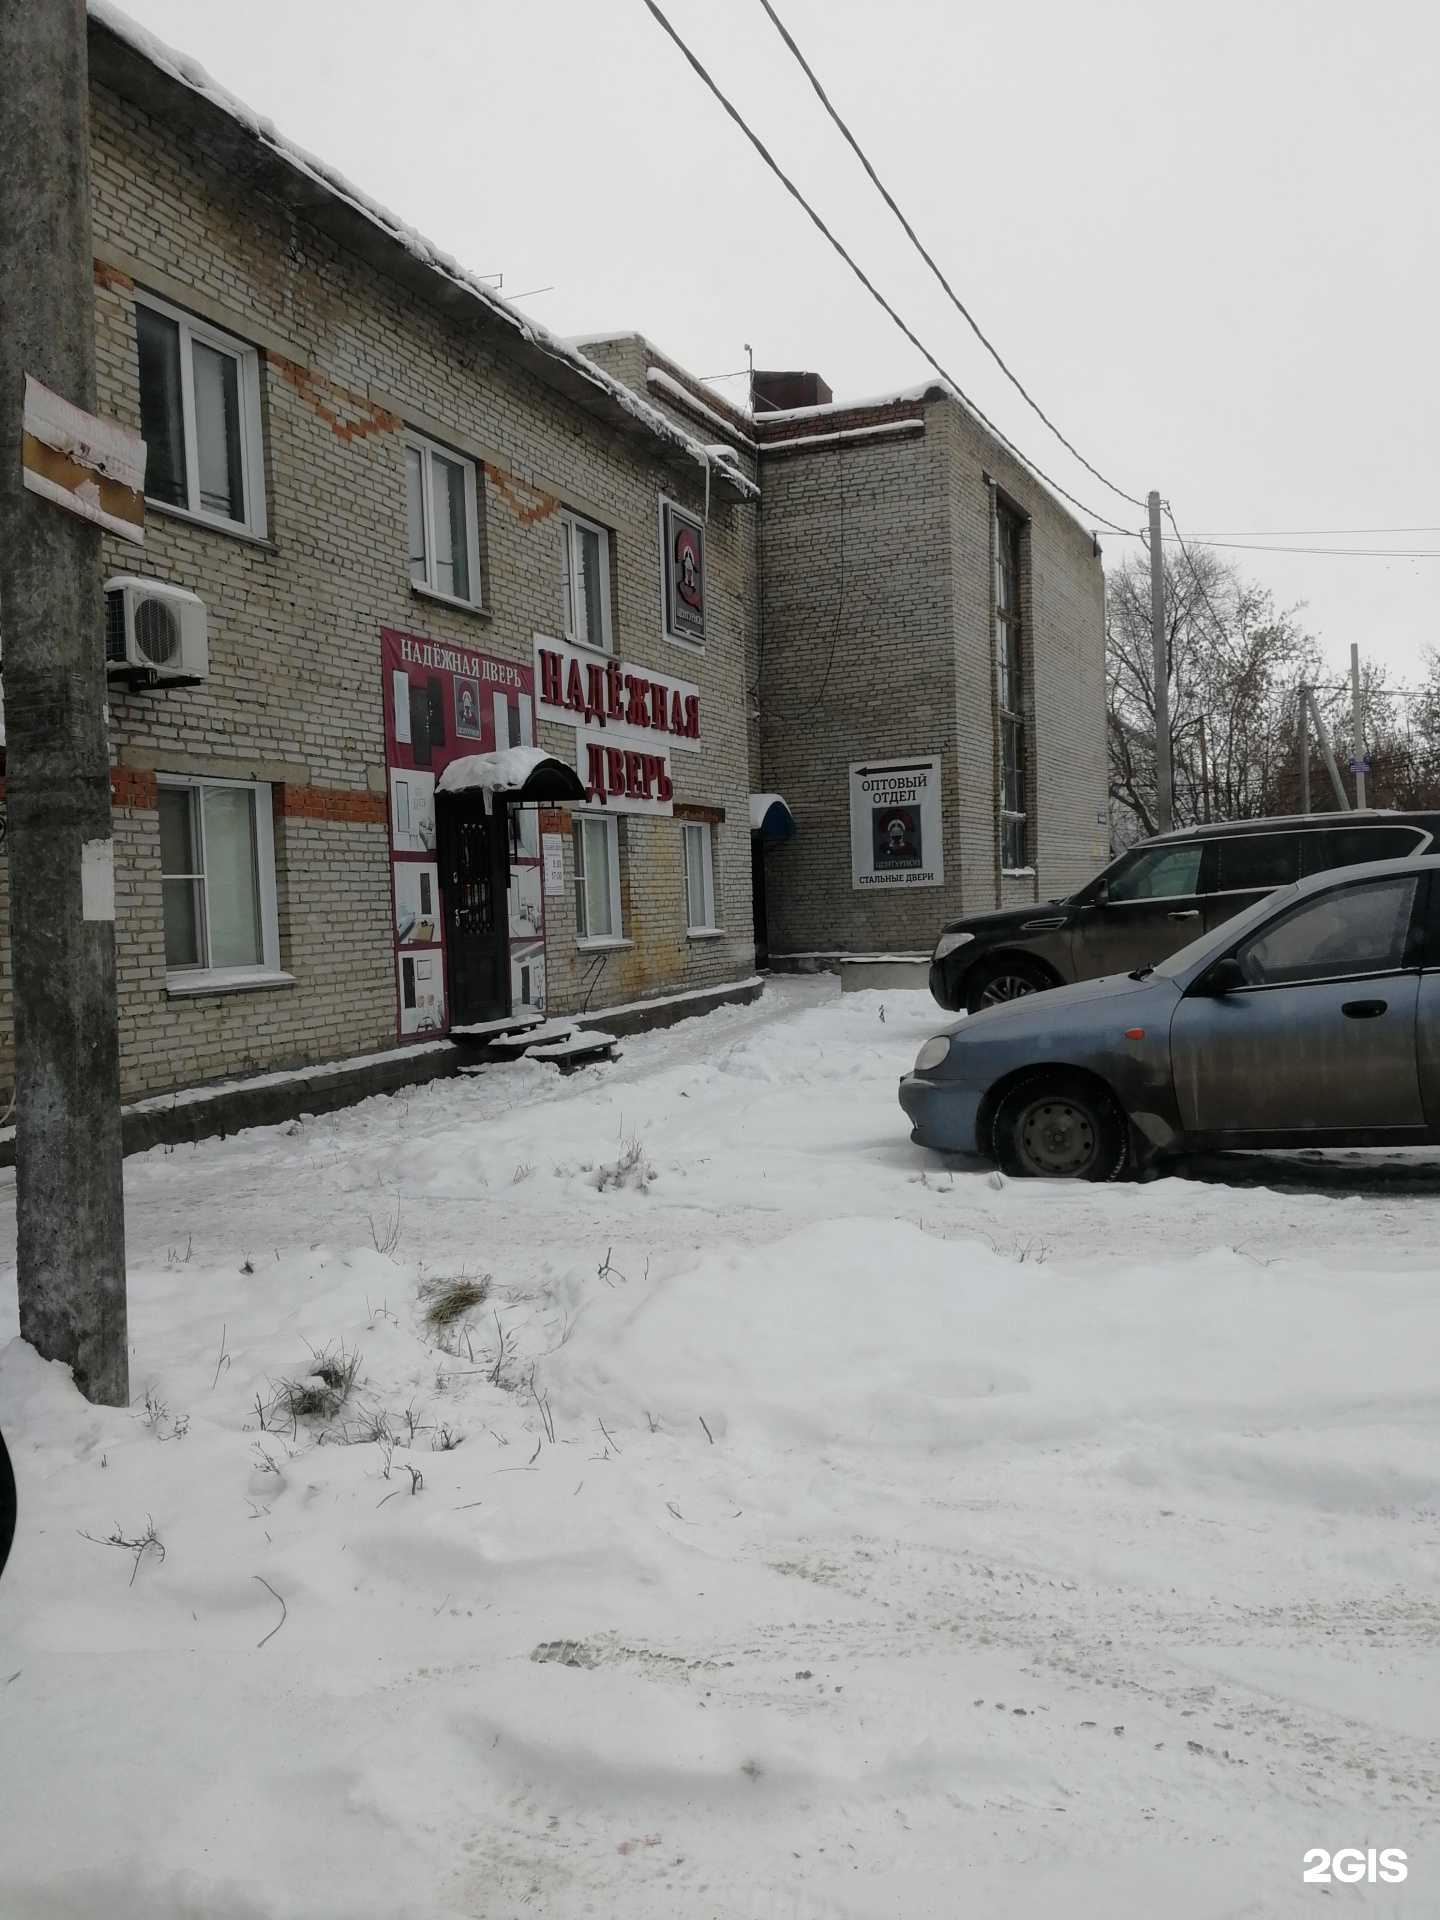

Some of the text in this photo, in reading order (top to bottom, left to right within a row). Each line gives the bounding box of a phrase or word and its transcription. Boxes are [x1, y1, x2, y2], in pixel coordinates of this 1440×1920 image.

[400, 639, 522, 688] НАДЁЖНАЯ ДВЕРЬ
[538, 648, 701, 739] НАДЁЖНАЯ
[585, 743, 674, 805] ДВЕРЬ
[861, 773, 928, 792] ОПТОВЫЙ
[872, 790, 917, 805] ОТДЕЛ
[859, 873, 934, 884] СТАЛЬНЫЕ ДВЕРИ
